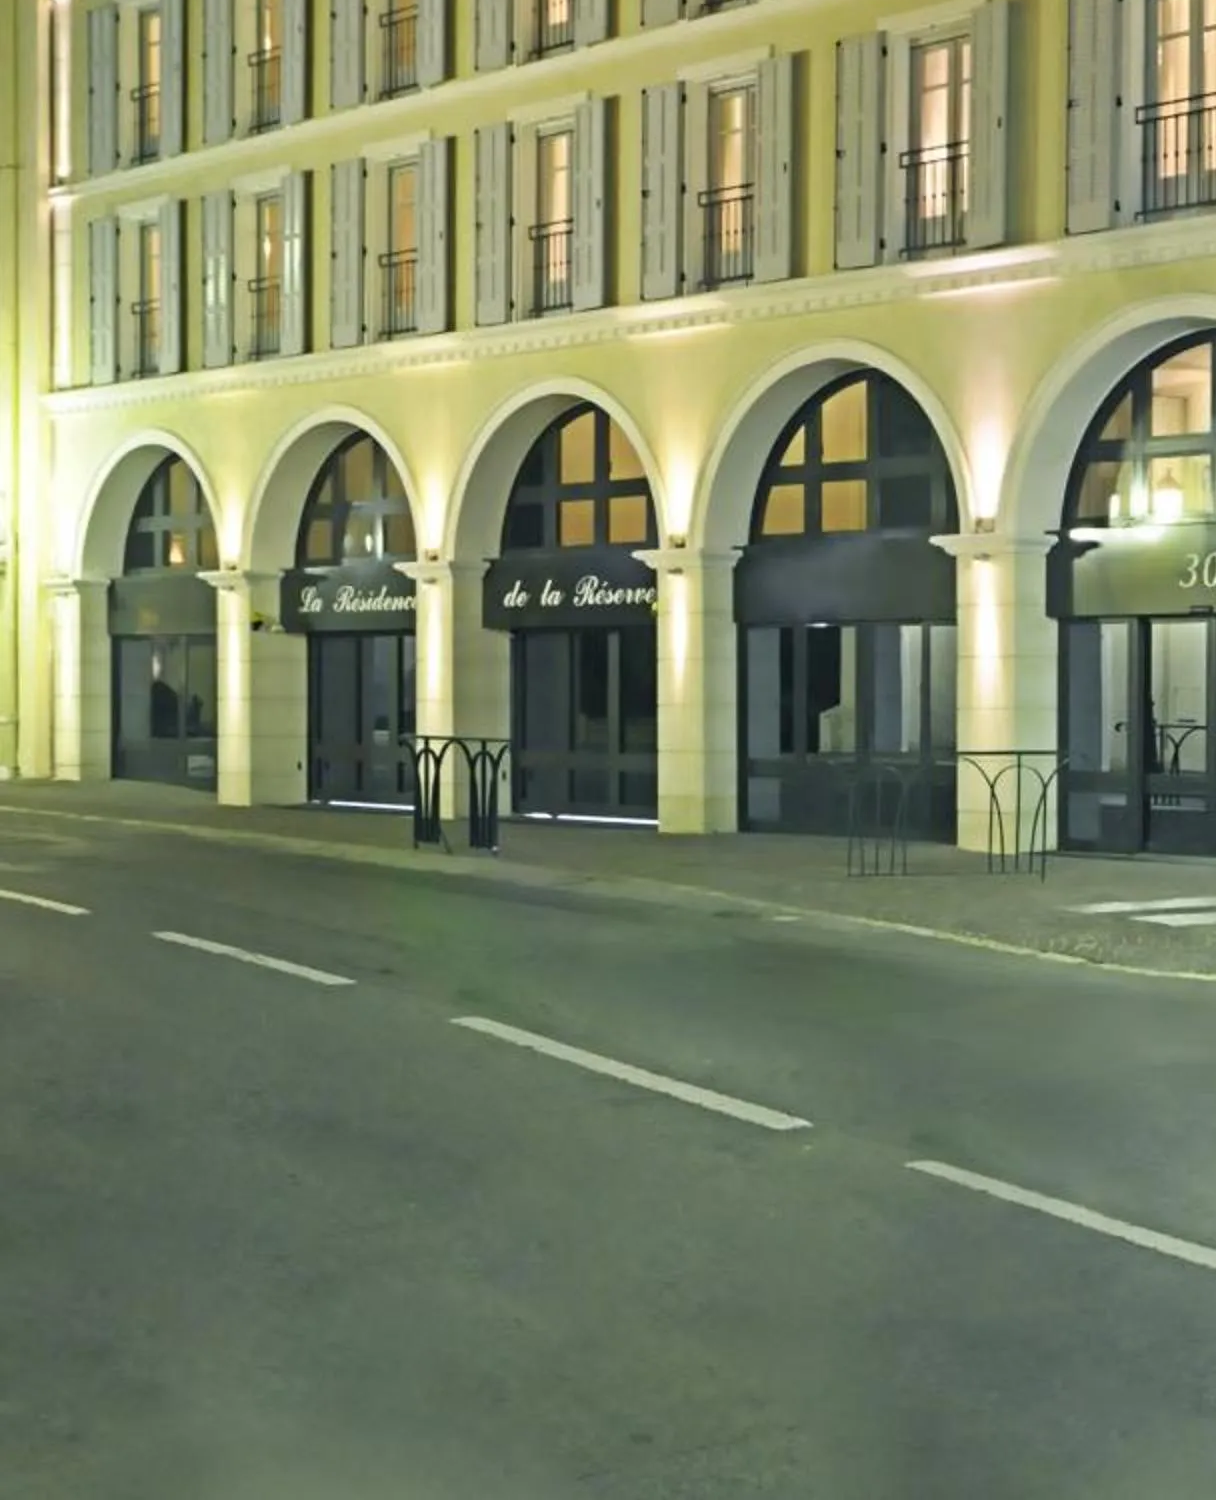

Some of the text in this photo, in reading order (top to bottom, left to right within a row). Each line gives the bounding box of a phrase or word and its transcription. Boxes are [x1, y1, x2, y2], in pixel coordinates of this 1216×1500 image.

[298, 586, 322, 612] La
[503, 575, 656, 607] de la Réserve
